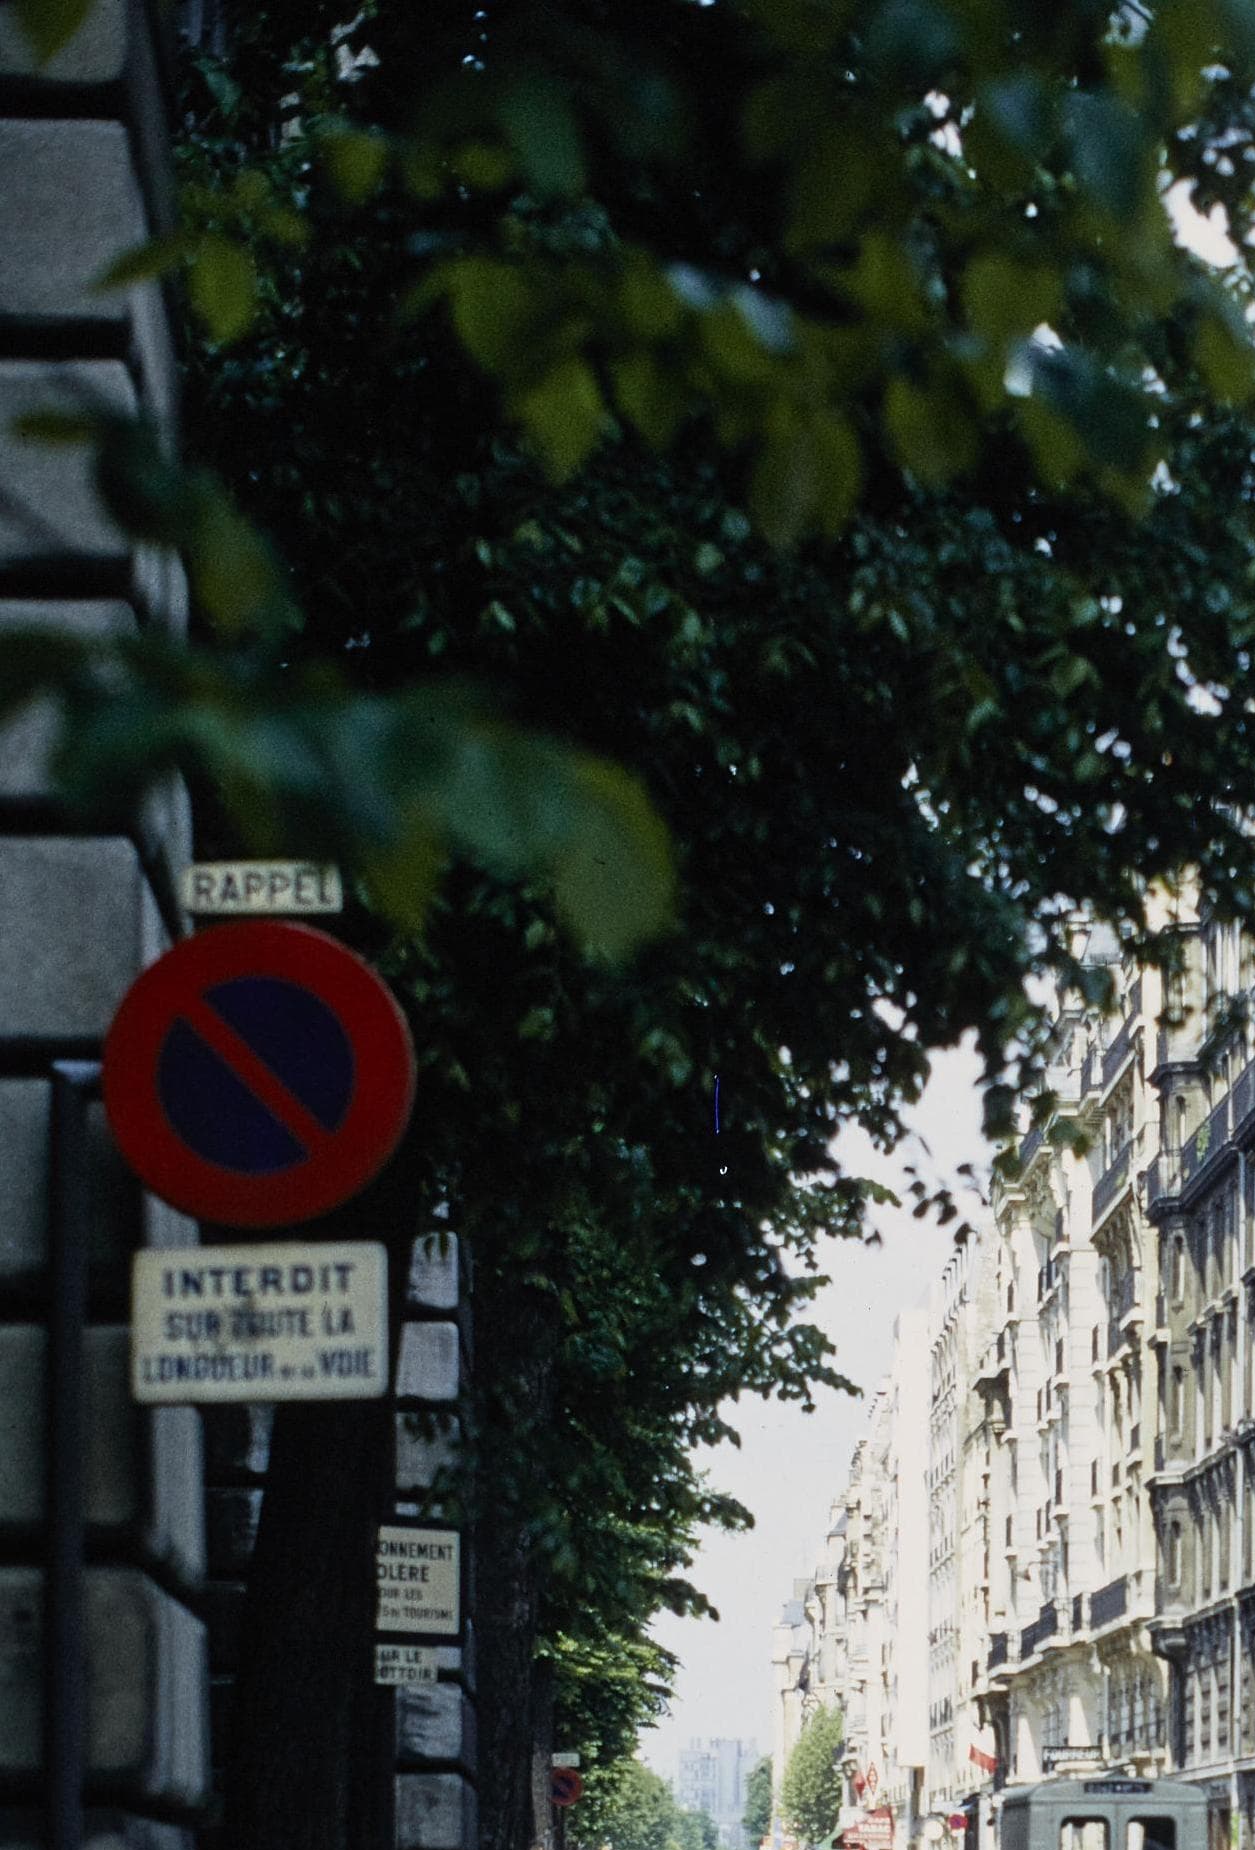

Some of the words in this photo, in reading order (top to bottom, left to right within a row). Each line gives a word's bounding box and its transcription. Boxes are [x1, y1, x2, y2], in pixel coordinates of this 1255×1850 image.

[193, 869, 336, 905] RAPPEL
[164, 1262, 354, 1298] INTERDIT
[165, 1310, 222, 1341] SUR
[231, 1307, 311, 1339] TOUTE
[322, 1305, 355, 1336] LA
[318, 1347, 376, 1378] VOIE
[377, 1540, 453, 1561] ONNEMENT
[378, 1586, 399, 1599] OUR
[380, 1649, 400, 1663] UR
[380, 1665, 432, 1681] OTTOIR
